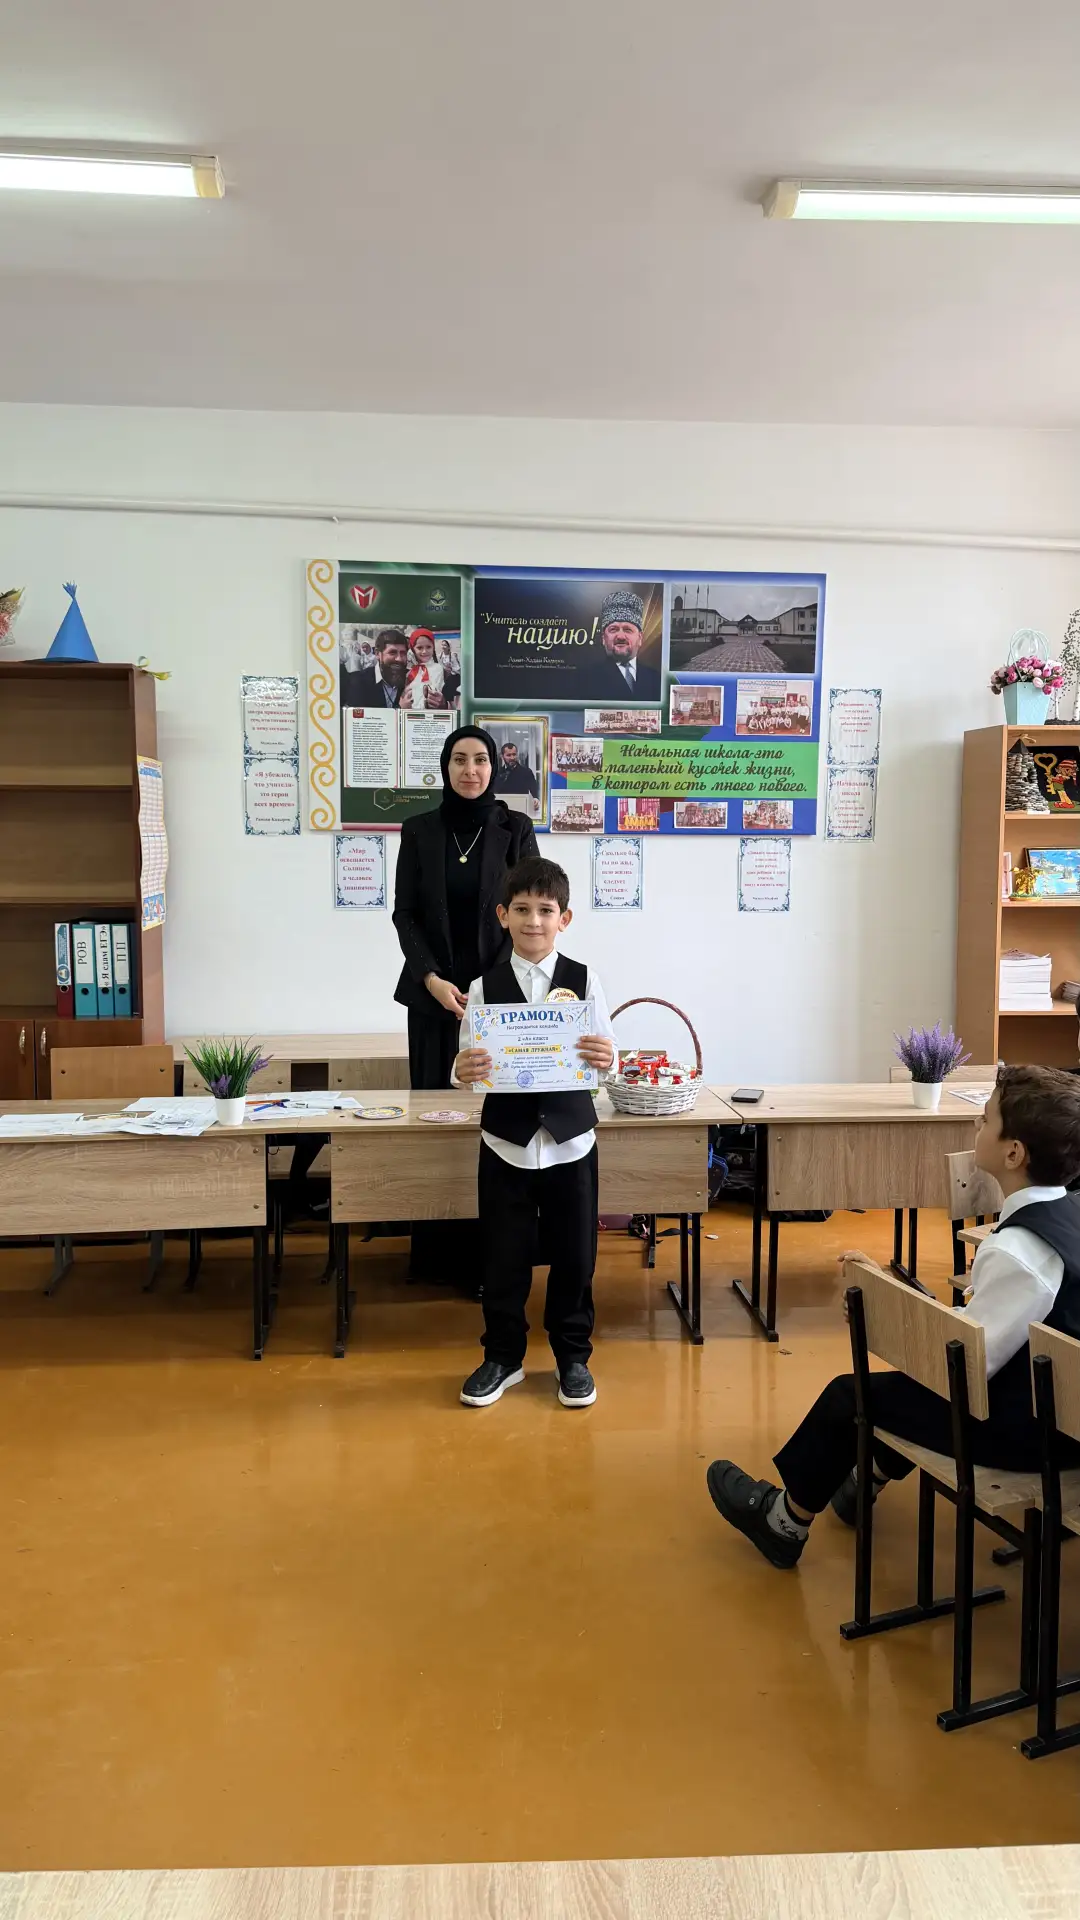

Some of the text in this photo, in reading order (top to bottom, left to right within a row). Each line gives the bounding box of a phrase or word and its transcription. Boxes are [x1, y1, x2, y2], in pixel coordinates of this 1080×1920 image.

[480, 612, 527, 624] "Учитель
[620, 744, 784, 759] Начальная школа-это
[604, 760, 796, 779] маленький кусочек жизни,
[592, 776, 807, 794] в котором есть много нового.
[500, 1010, 565, 1024] ГРАМОТА
